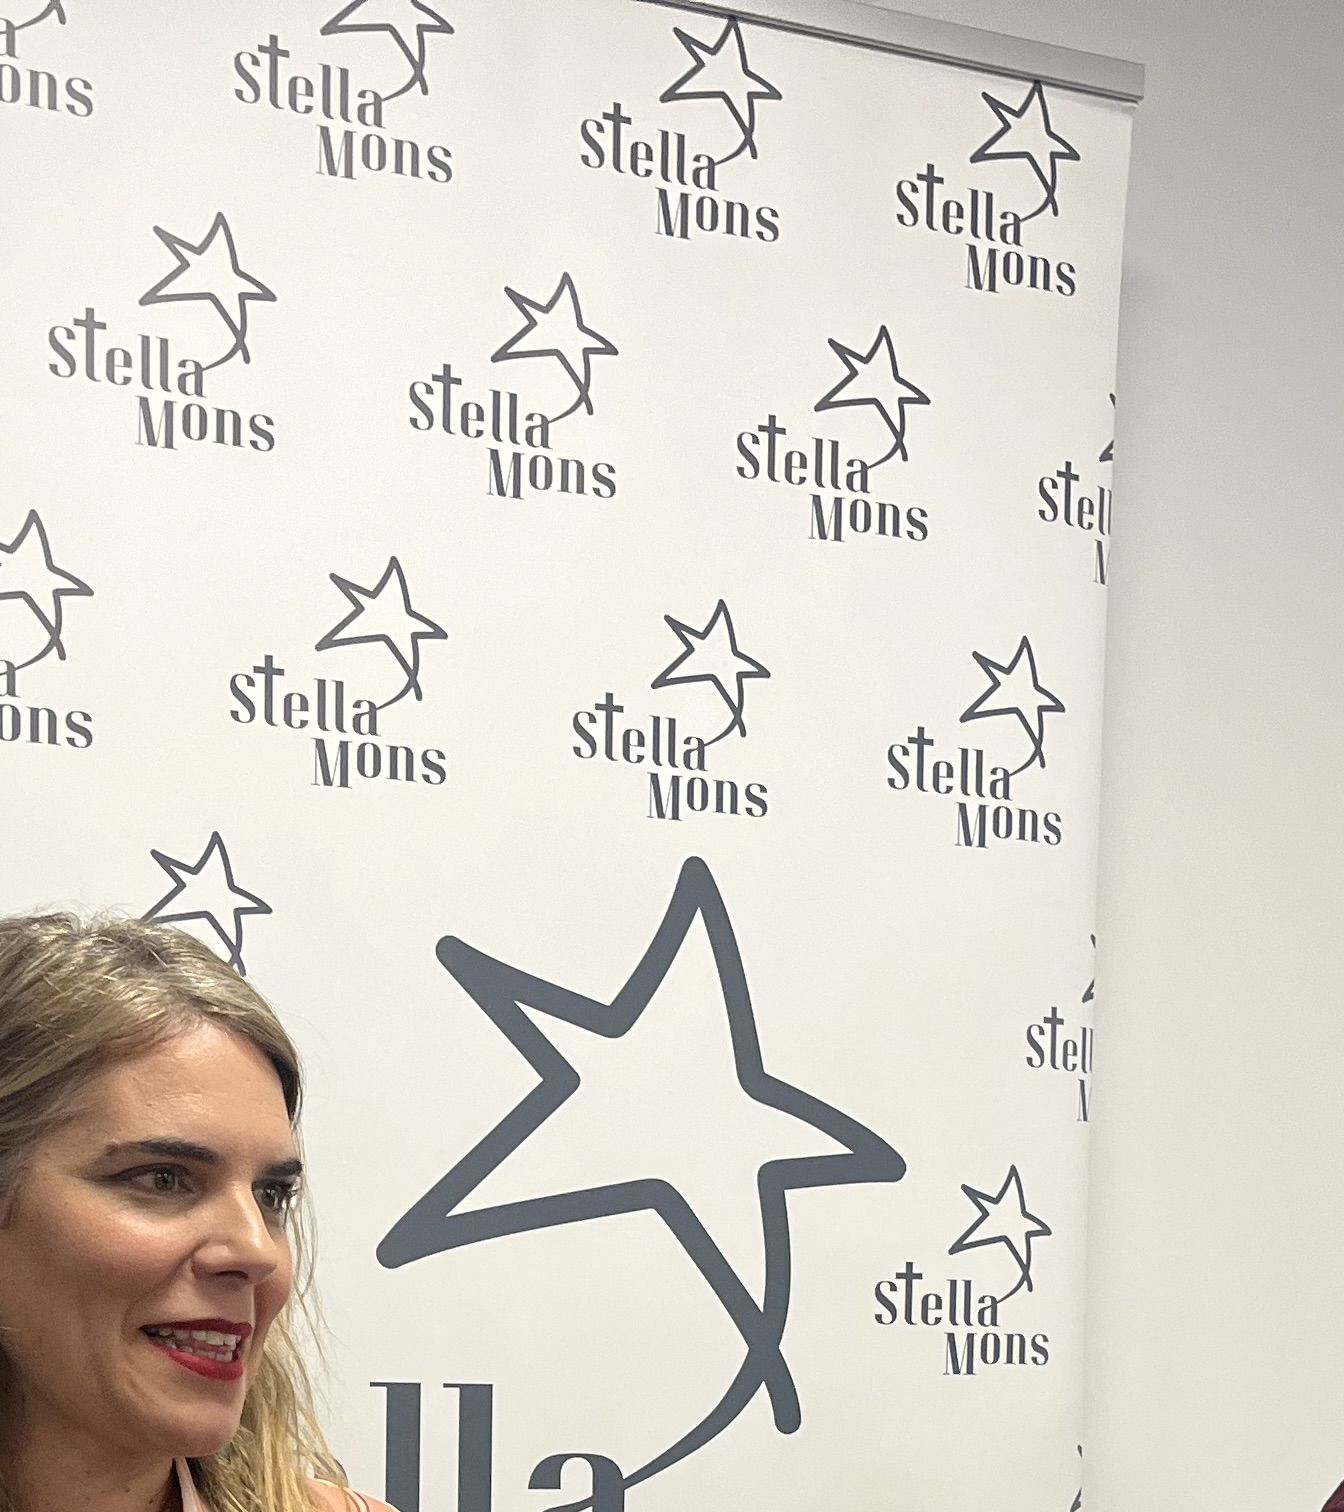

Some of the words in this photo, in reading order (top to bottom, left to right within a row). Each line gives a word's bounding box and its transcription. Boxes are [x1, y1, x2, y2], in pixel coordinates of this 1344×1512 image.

[233, 34, 387, 128] Stella
[315, 124, 453, 184] Mons
[580, 102, 719, 191] Stella
[656, 187, 781, 243] Mons
[895, 163, 1024, 247] Stella
[964, 244, 1077, 297] Mons
[48, 307, 207, 398] Stella
[134, 395, 276, 452] Mons
[409, 364, 553, 449] Stella
[486, 447, 617, 500] Mons
[736, 414, 872, 494] Stella
[808, 494, 929, 542] Mons
[229, 655, 381, 737] Stella
[311, 737, 448, 789] Mons
[572, 692, 709, 771] Stella
[887, 727, 1014, 800] Stella
[646, 772, 769, 821] Mons
[954, 802, 1063, 849] Mons
[874, 1262, 1001, 1328] Stella
[943, 1331, 1050, 1376] Mons
